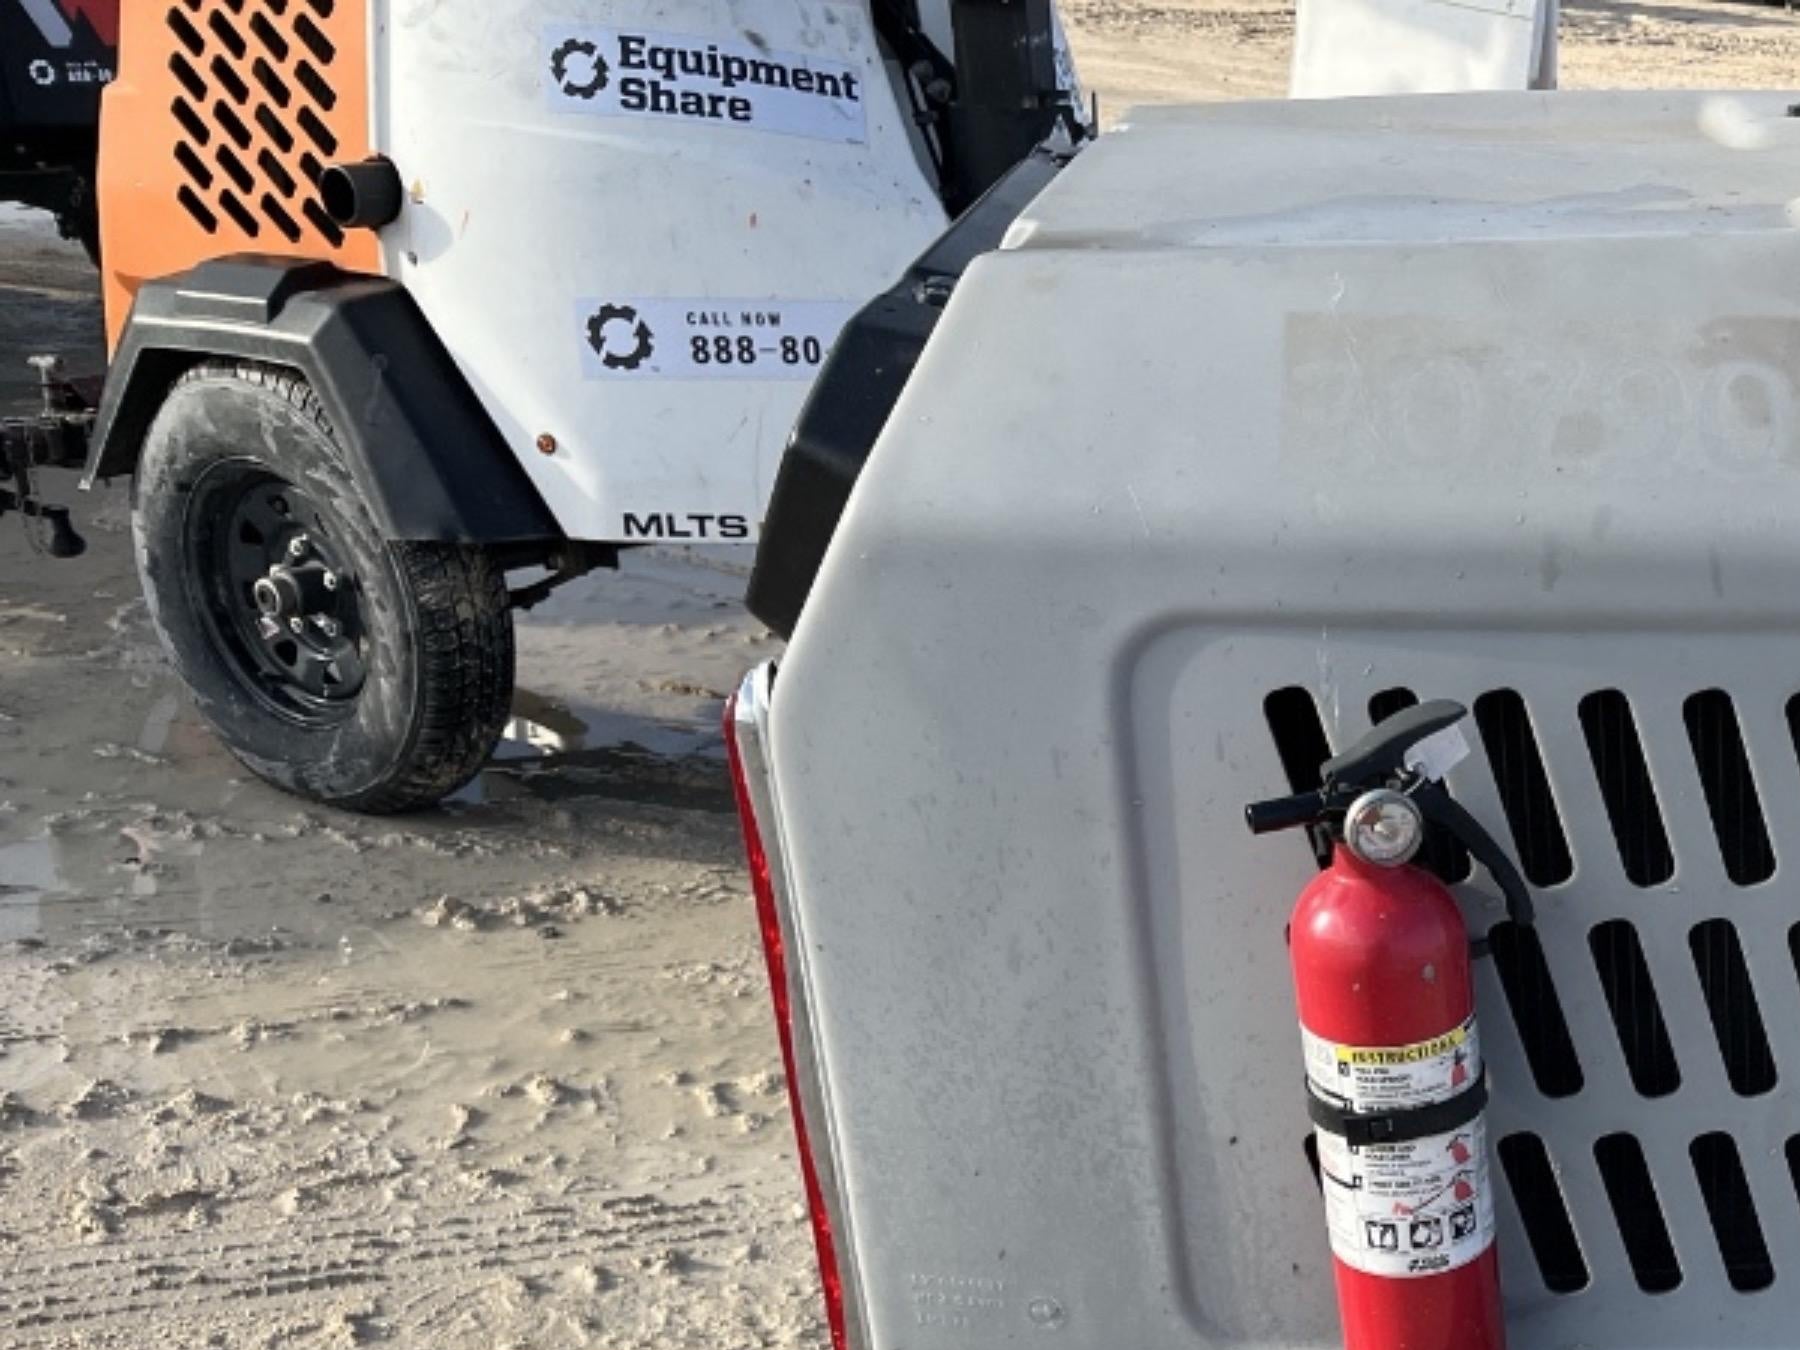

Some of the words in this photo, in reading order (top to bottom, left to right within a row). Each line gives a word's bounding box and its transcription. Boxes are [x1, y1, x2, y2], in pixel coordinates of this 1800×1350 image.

[617, 34, 859, 101] Equipment
[619, 76, 752, 121] Share
[686, 311, 733, 327] CALL
[740, 311, 781, 327] NOW
[623, 512, 748, 537] MLTS
